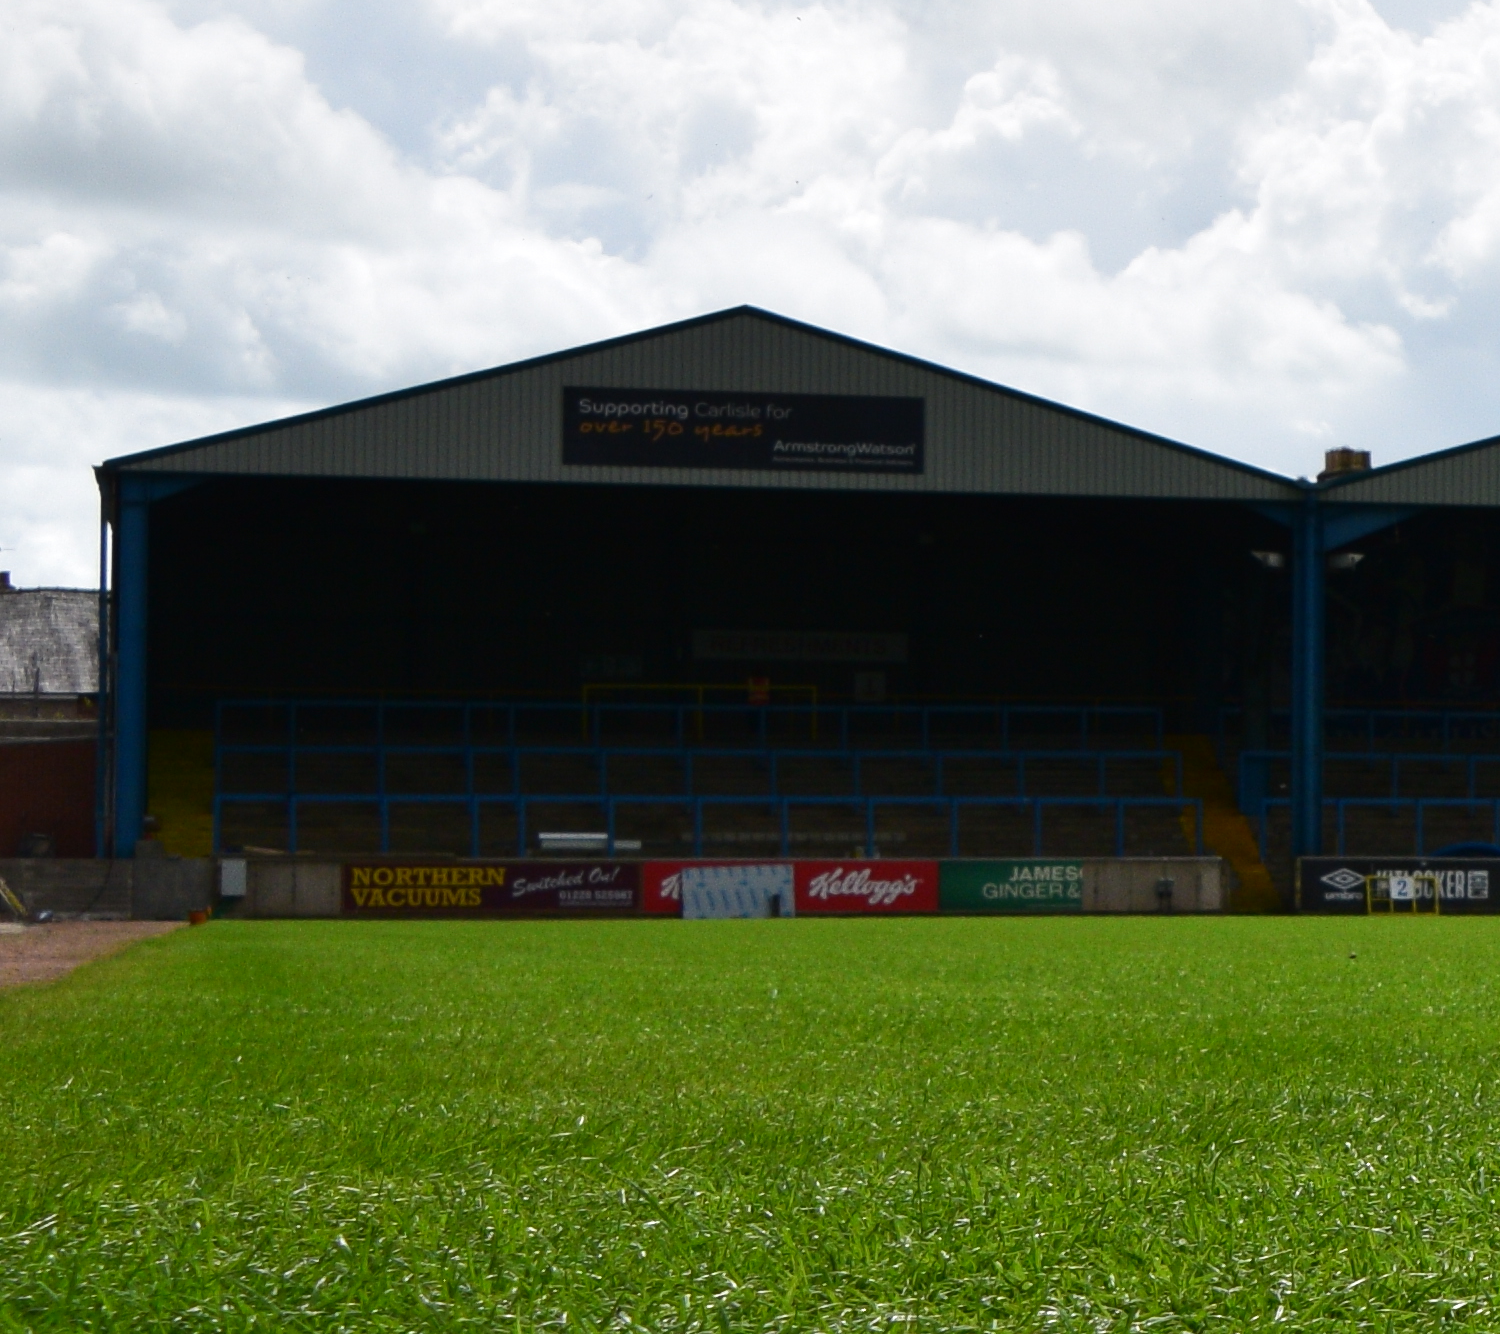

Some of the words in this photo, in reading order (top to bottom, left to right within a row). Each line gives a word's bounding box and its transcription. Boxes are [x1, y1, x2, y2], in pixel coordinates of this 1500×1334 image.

[579, 398, 690, 421] Supporting
[695, 401, 763, 419] Carlisle
[766, 402, 793, 419] for
[580, 420, 634, 434] over
[642, 419, 685, 443] 150
[695, 423, 765, 443] years
[351, 866, 507, 886] NORTHERN
[512, 871, 585, 899] Switched
[588, 865, 622, 885] On!
[1009, 866, 1084, 881] JAMES
[808, 868, 918, 904] Kellogg's
[983, 882, 1066, 899] GINGER
[1067, 882, 1081, 899] &
[1397, 880, 1408, 897] 2
[351, 887, 482, 907] VACUUMS
